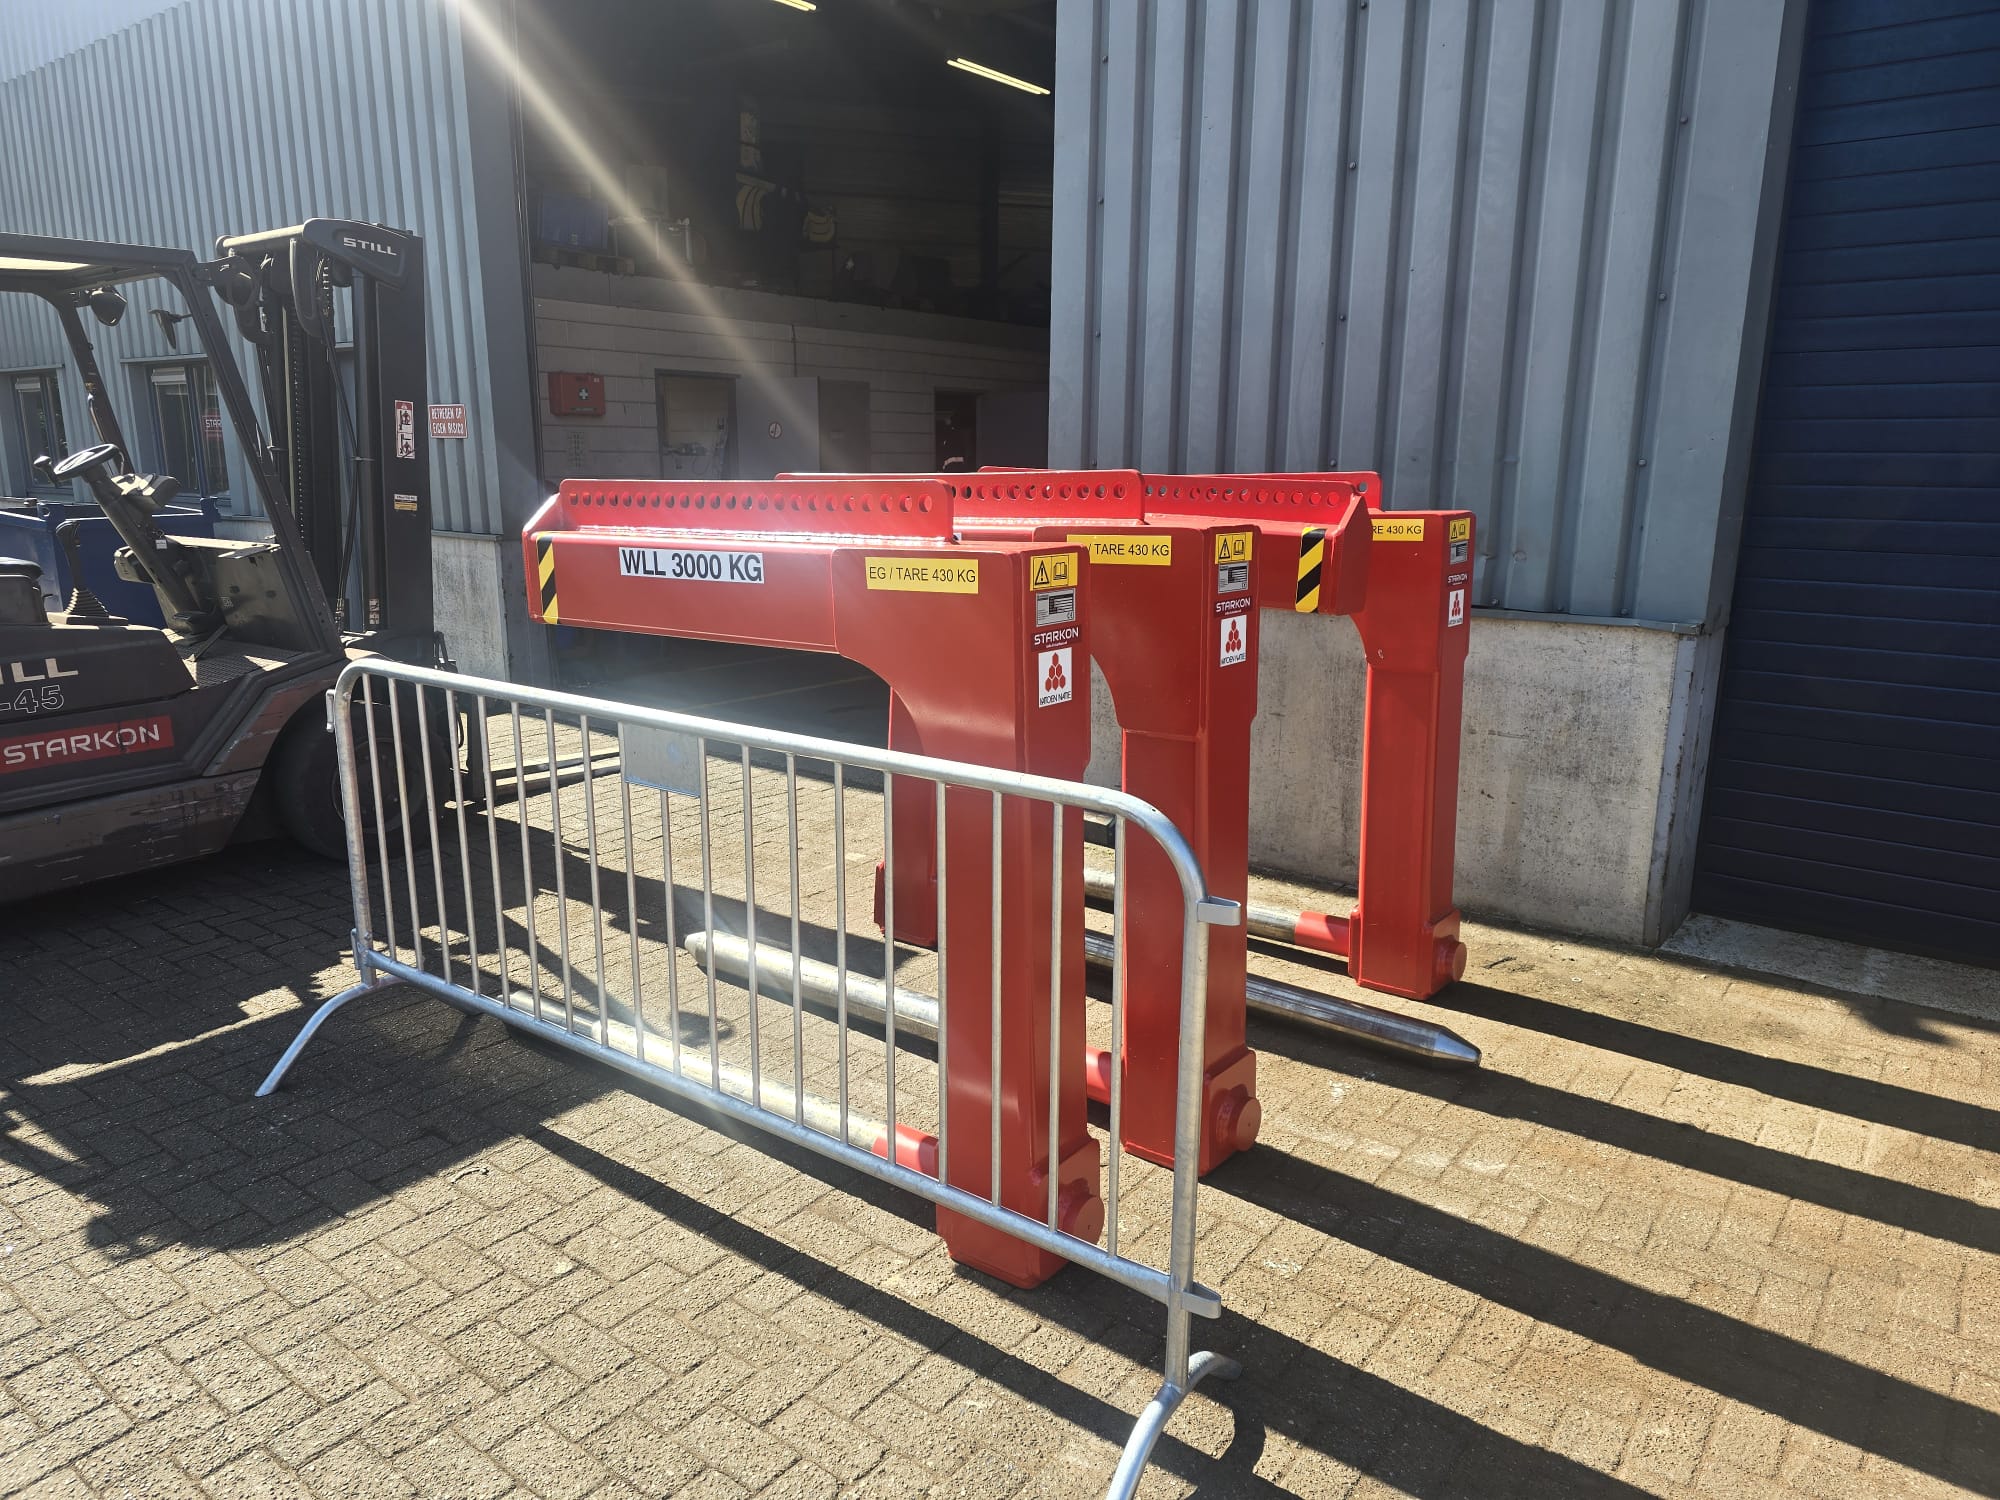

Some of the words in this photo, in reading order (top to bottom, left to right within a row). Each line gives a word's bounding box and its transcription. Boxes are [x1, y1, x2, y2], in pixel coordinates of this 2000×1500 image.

[343, 237, 397, 256] STILL
[1386, 525, 1404, 535] 430
[1406, 525, 1422, 535] KG
[1094, 543, 1125, 556] TARE
[1127, 544, 1149, 557] 430
[1151, 544, 1170, 557] KG
[621, 549, 666, 576] WLL
[671, 552, 722, 580] 3000
[728, 554, 763, 582] KG
[869, 566, 886, 580] EG
[889, 567, 893, 580] /
[895, 567, 929, 581] TARE
[931, 568, 954, 582] 430
[957, 569, 976, 583] KG
[1216, 597, 1250, 612] STARKON
[1034, 627, 1078, 645] STARKON
[4, 723, 161, 765] STARKON
